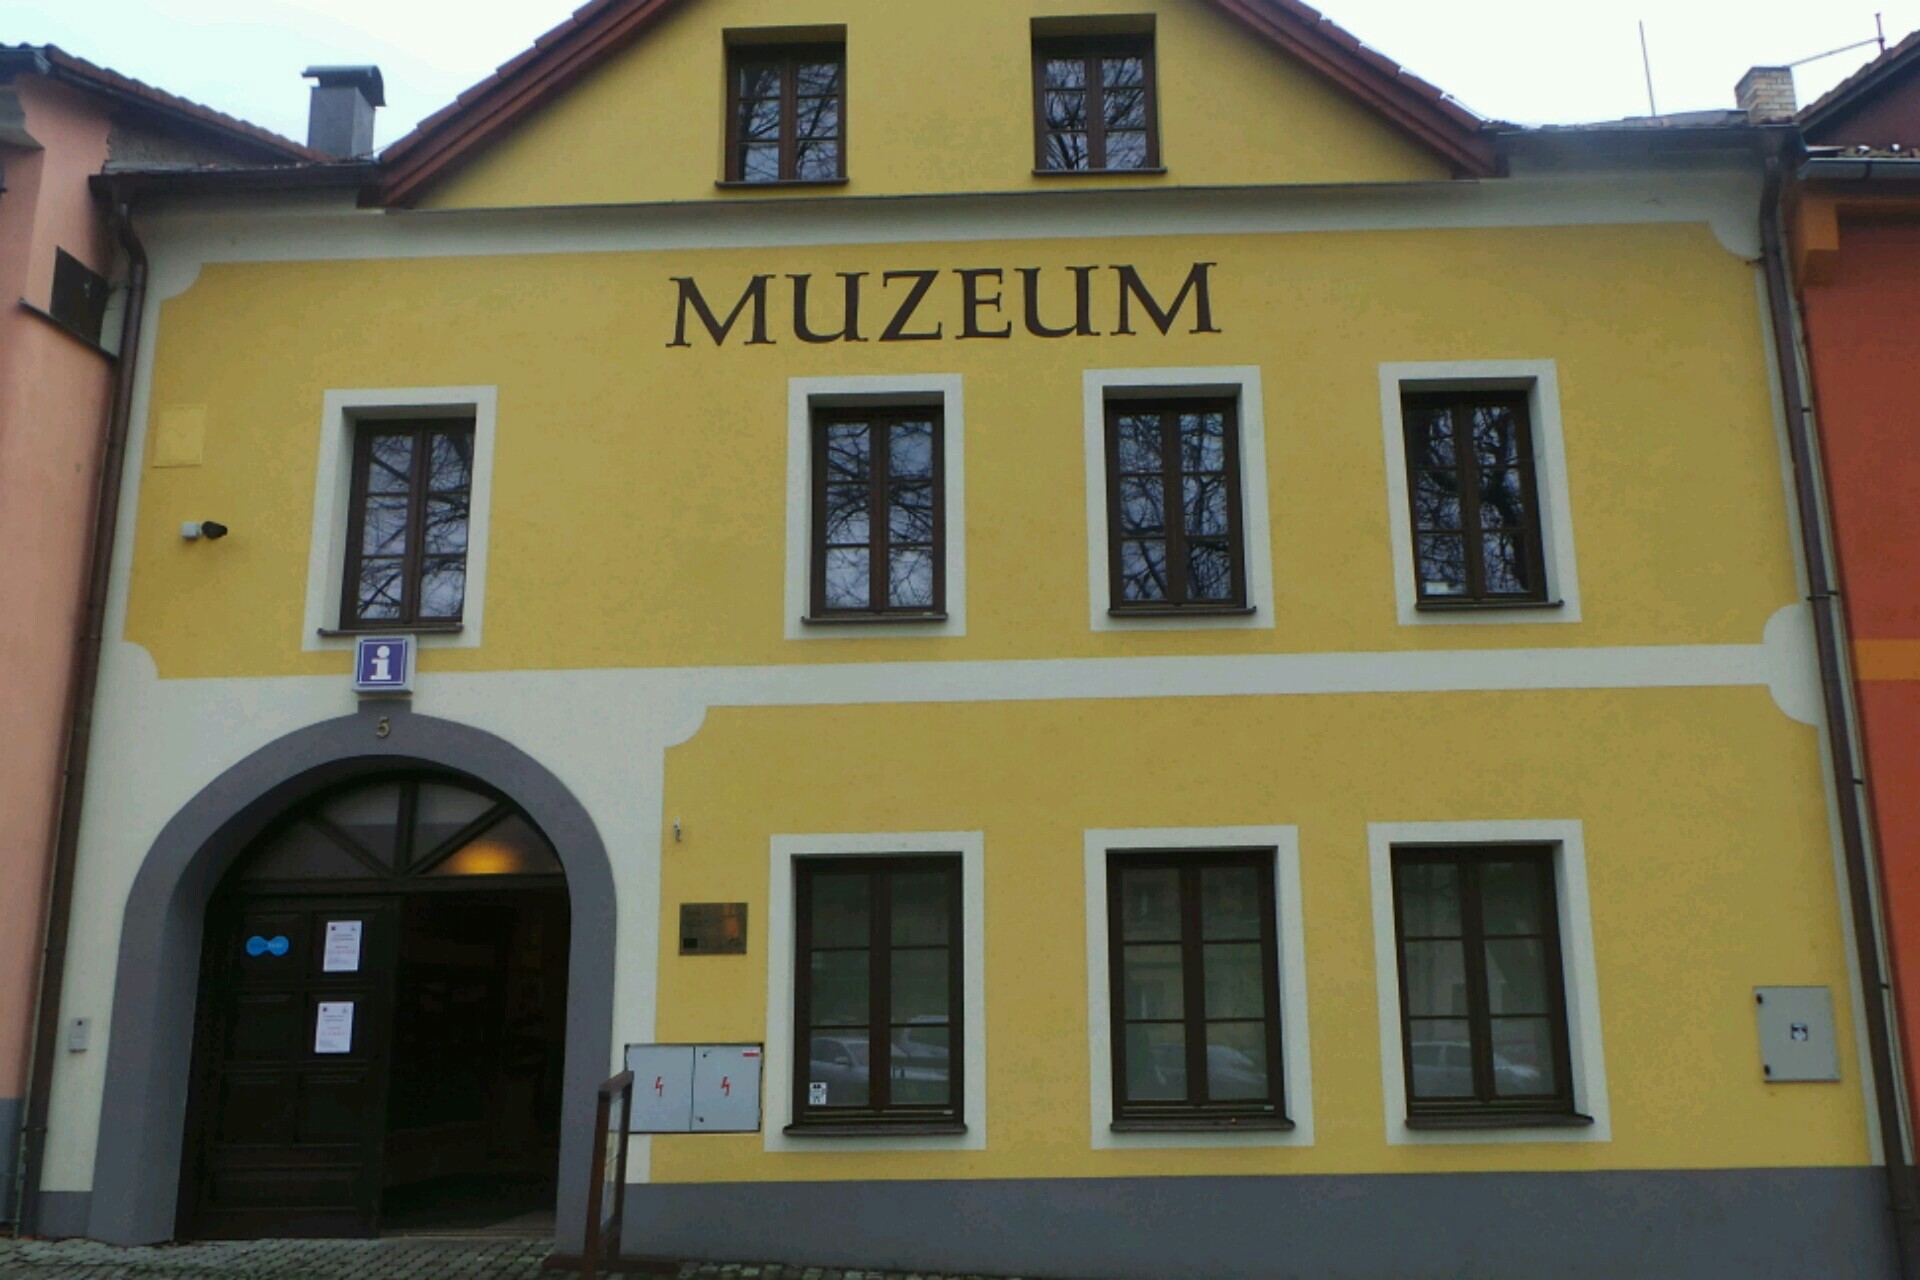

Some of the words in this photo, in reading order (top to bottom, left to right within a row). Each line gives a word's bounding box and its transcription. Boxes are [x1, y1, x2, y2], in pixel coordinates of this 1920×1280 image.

[666, 262, 1222, 348] MUZEUM
[371, 645, 392, 680] i
[376, 716, 391, 738] 5
